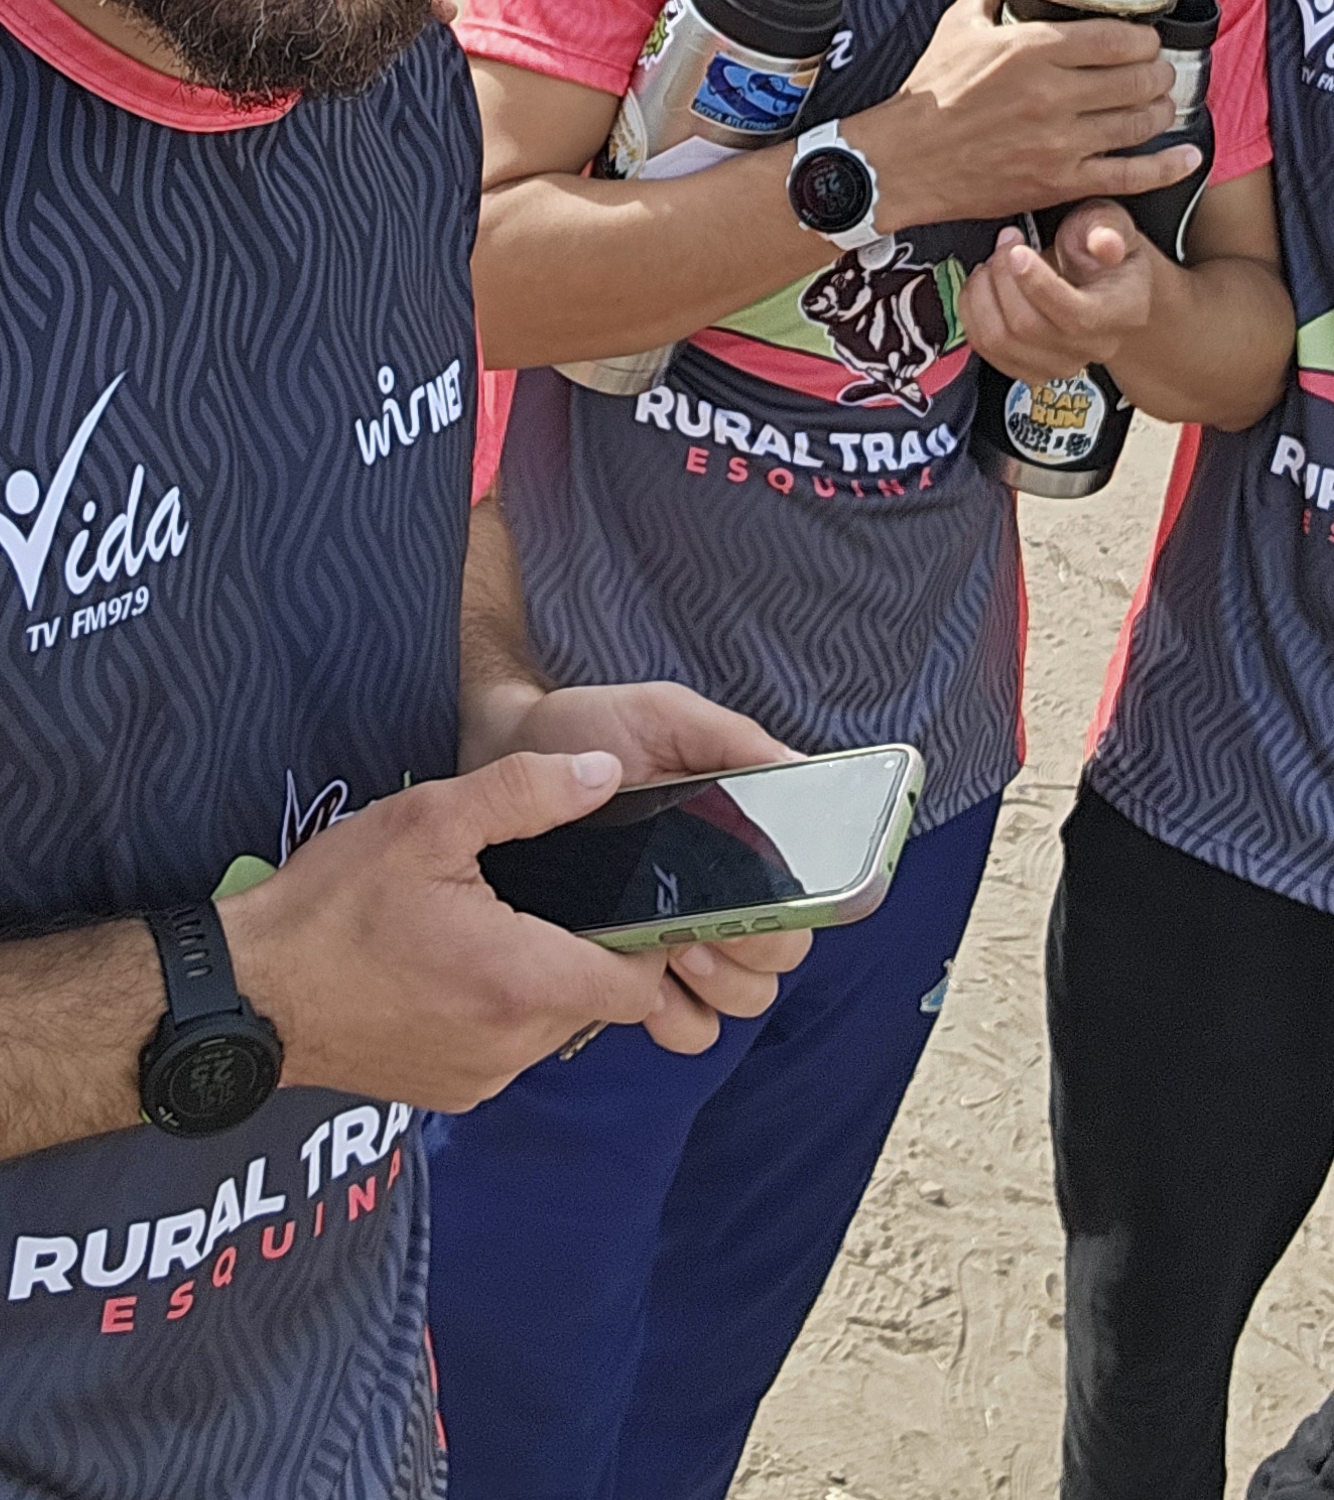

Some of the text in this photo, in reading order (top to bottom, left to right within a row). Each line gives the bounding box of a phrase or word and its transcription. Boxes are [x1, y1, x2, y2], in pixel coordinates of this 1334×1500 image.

[634, 385, 824, 469] RURAL
[1030, 404, 1087, 429] RUN
[685, 445, 934, 498] ESQUINA
[25, 616, 62, 653] TV
[7, 1156, 287, 1301] RURAL
